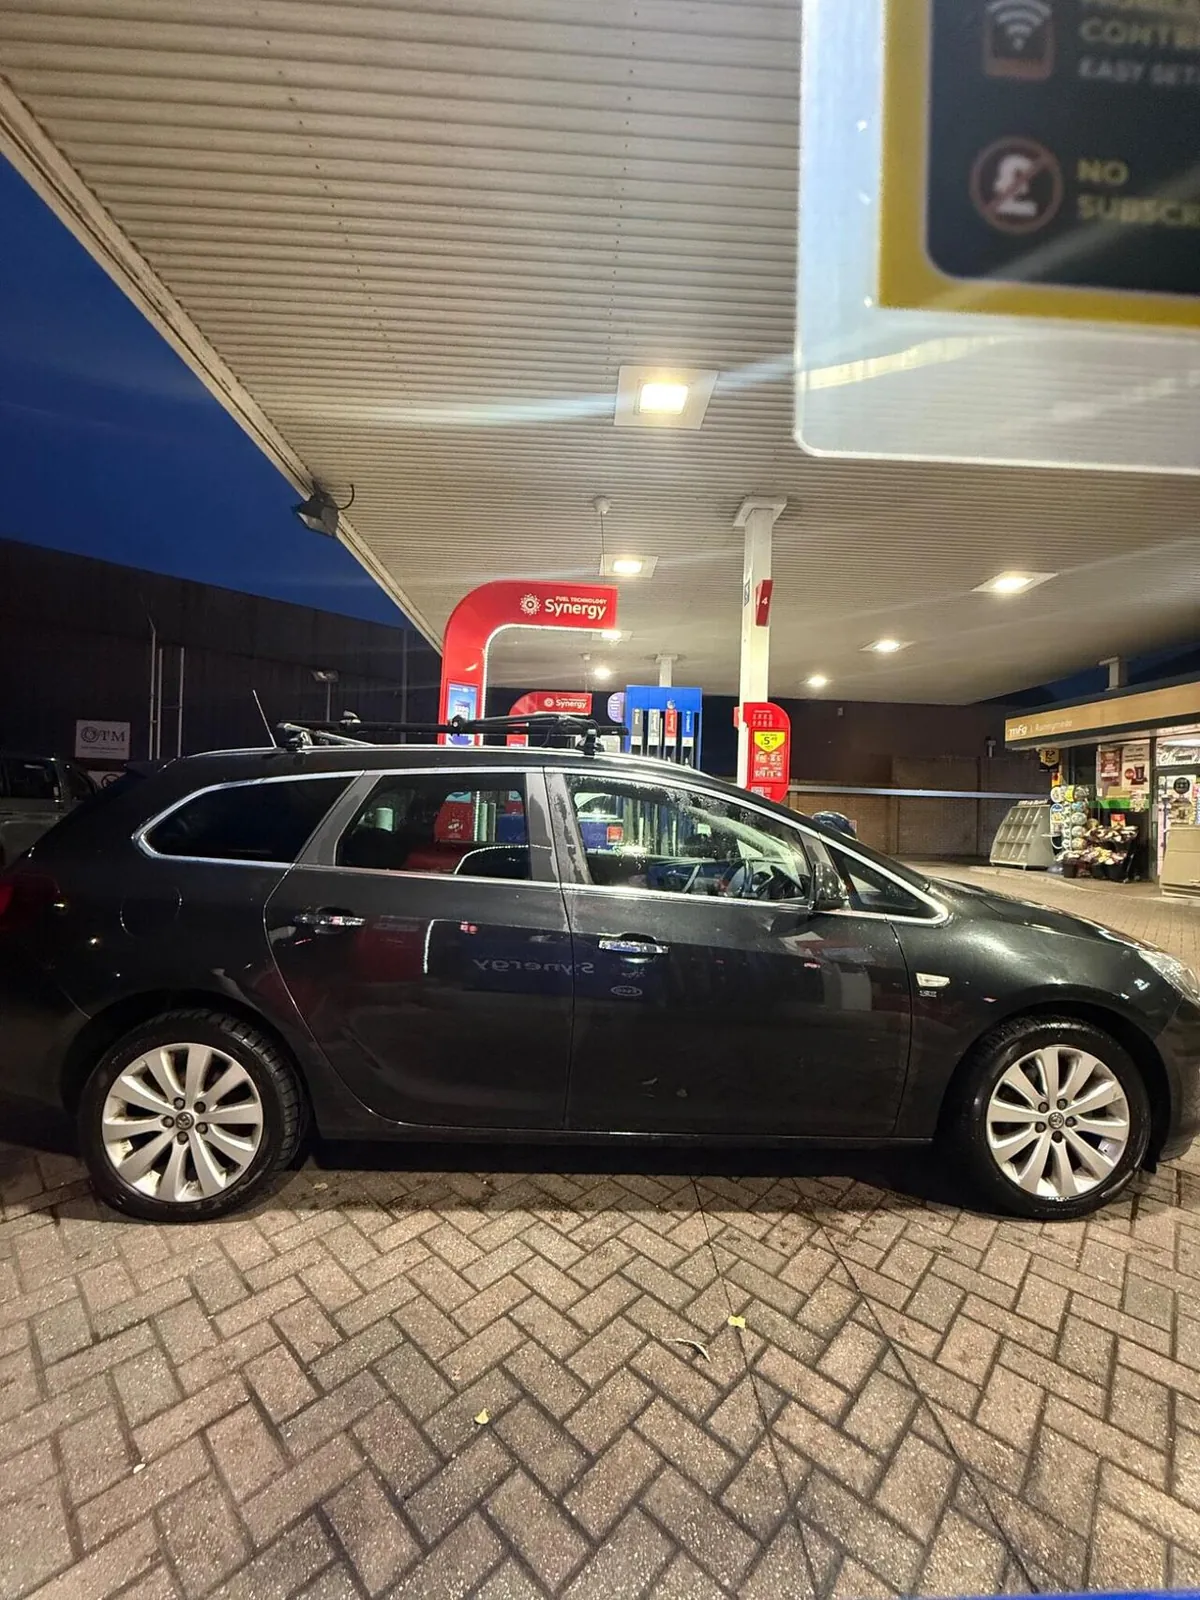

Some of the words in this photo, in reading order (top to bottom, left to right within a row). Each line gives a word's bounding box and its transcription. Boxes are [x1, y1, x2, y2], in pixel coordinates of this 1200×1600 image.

[1077, 159, 1128, 186] NO
[761, 596, 768, 605] 4
[545, 599, 606, 619] Synergy
[555, 699, 587, 709] Synergy
[1008, 724, 1028, 736] mfg
